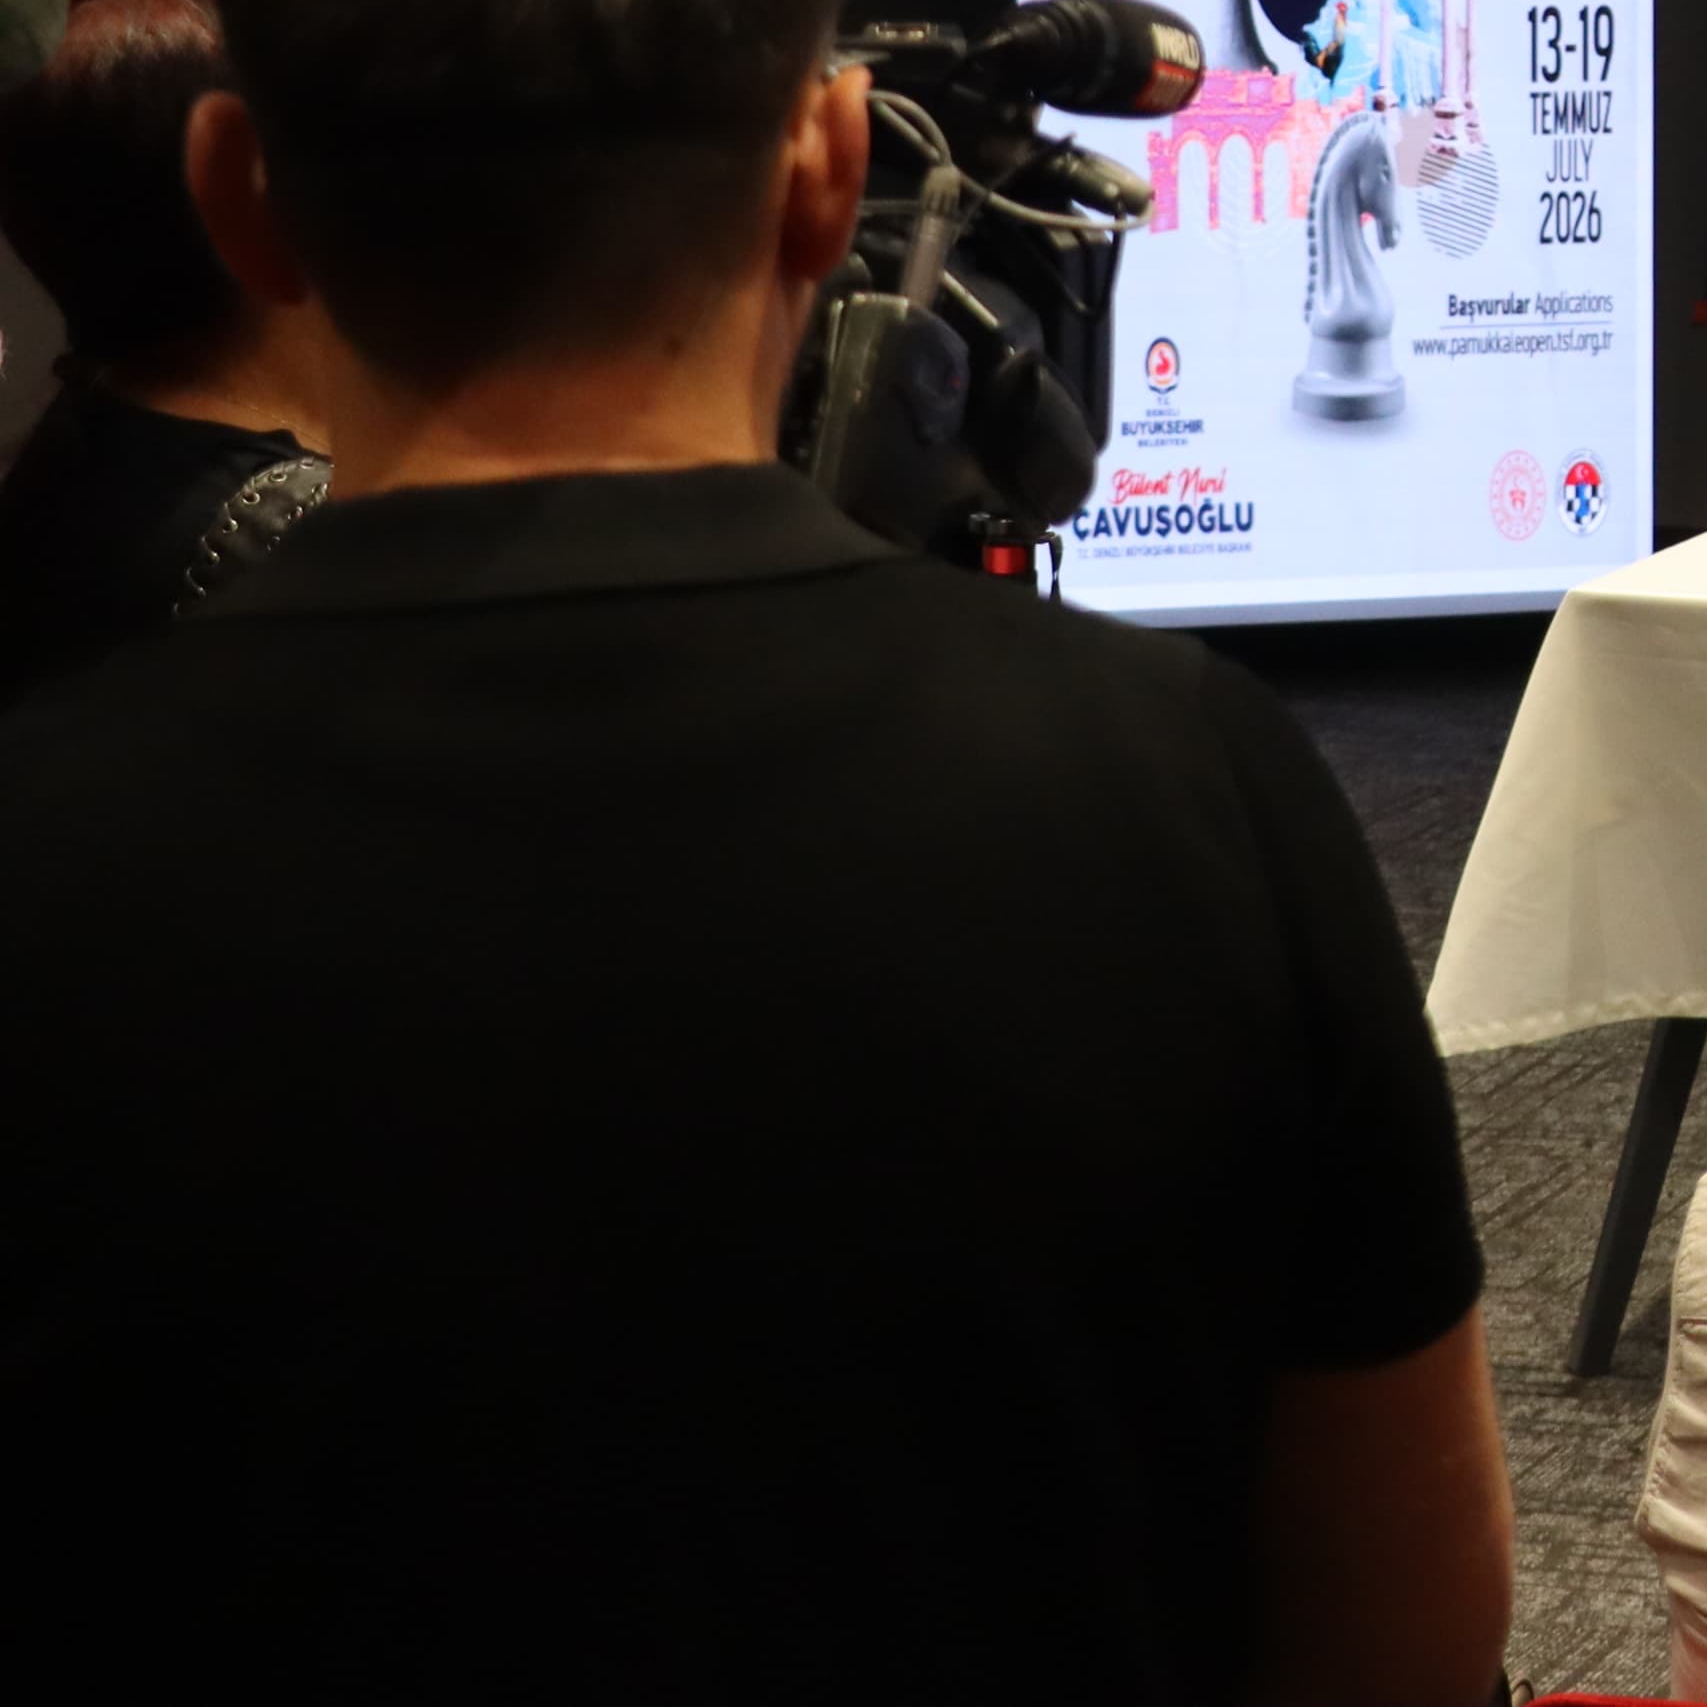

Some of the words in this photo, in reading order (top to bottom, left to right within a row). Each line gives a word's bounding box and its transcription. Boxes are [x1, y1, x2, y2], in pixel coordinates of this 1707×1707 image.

[1527, 4, 1615, 84] 13-19
[1529, 90, 1614, 136] TEMMUZ
[1545, 138, 1595, 183] JULY
[1539, 190, 1602, 245] 2026
[1448, 292, 1531, 323] Başvurular
[1534, 290, 1614, 323] Applications
[1072, 498, 1254, 541] ÇAVUŞOĞLU
